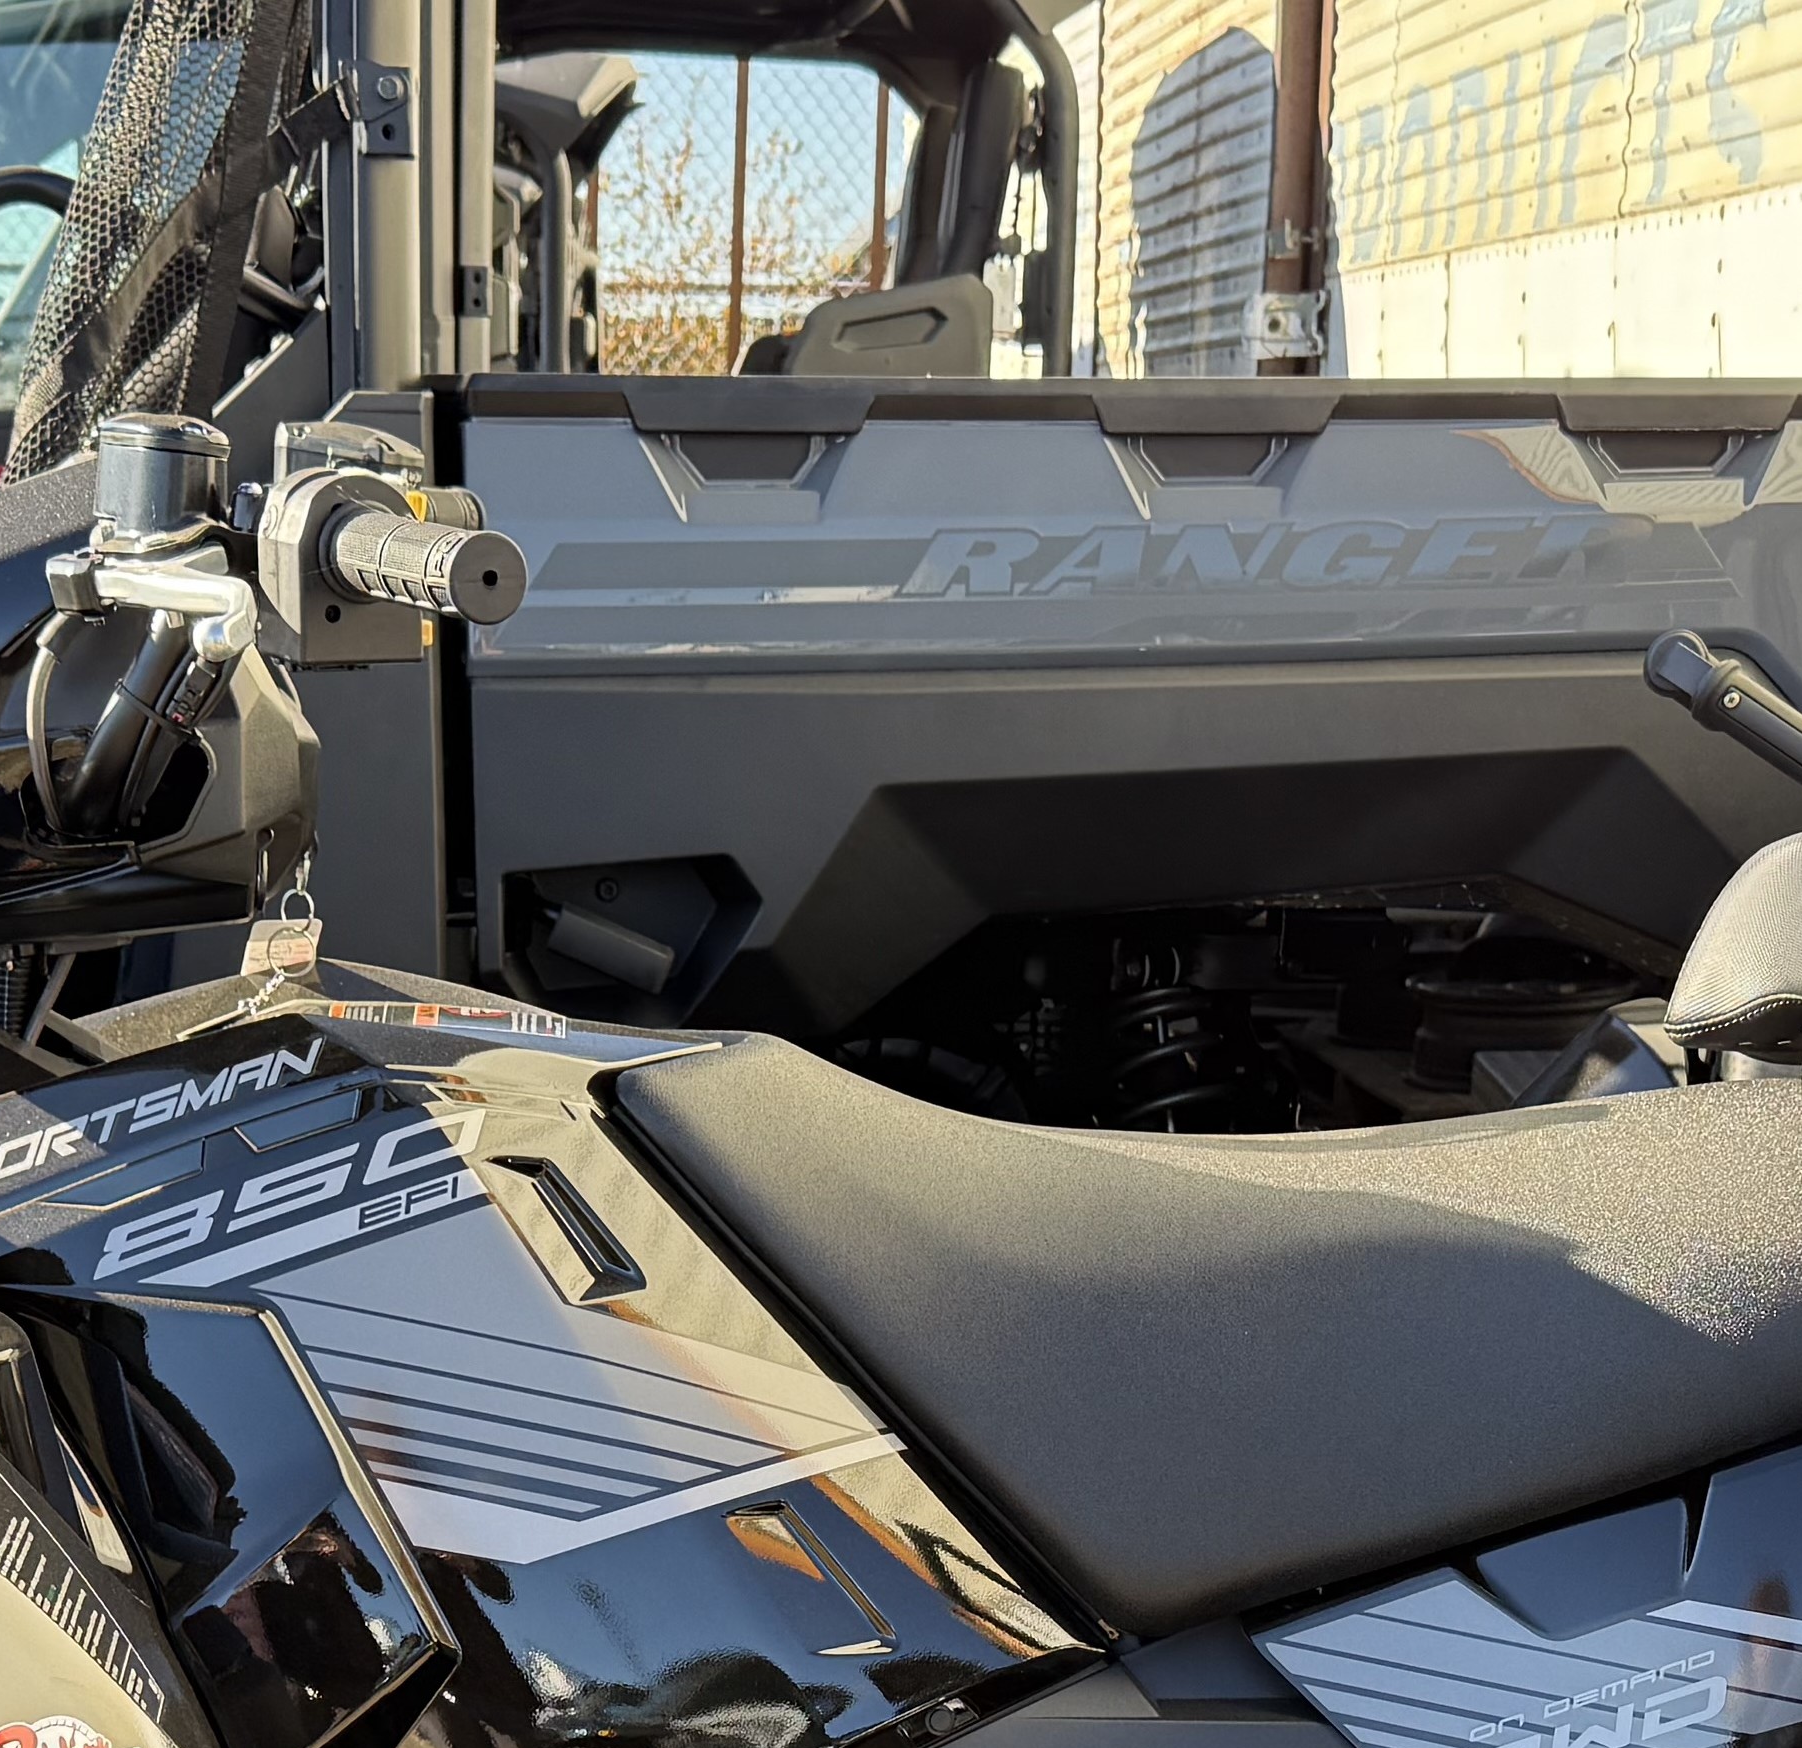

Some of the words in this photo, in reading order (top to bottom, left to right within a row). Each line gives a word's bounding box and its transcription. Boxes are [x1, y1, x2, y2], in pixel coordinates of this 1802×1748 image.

[899, 513, 1655, 599] RANGER
[93, 1107, 488, 1282] 850
[357, 1175, 460, 1232] EFI
[1469, 1713, 1525, 1742] ON
[1543, 1650, 1715, 1719] DEMAND
